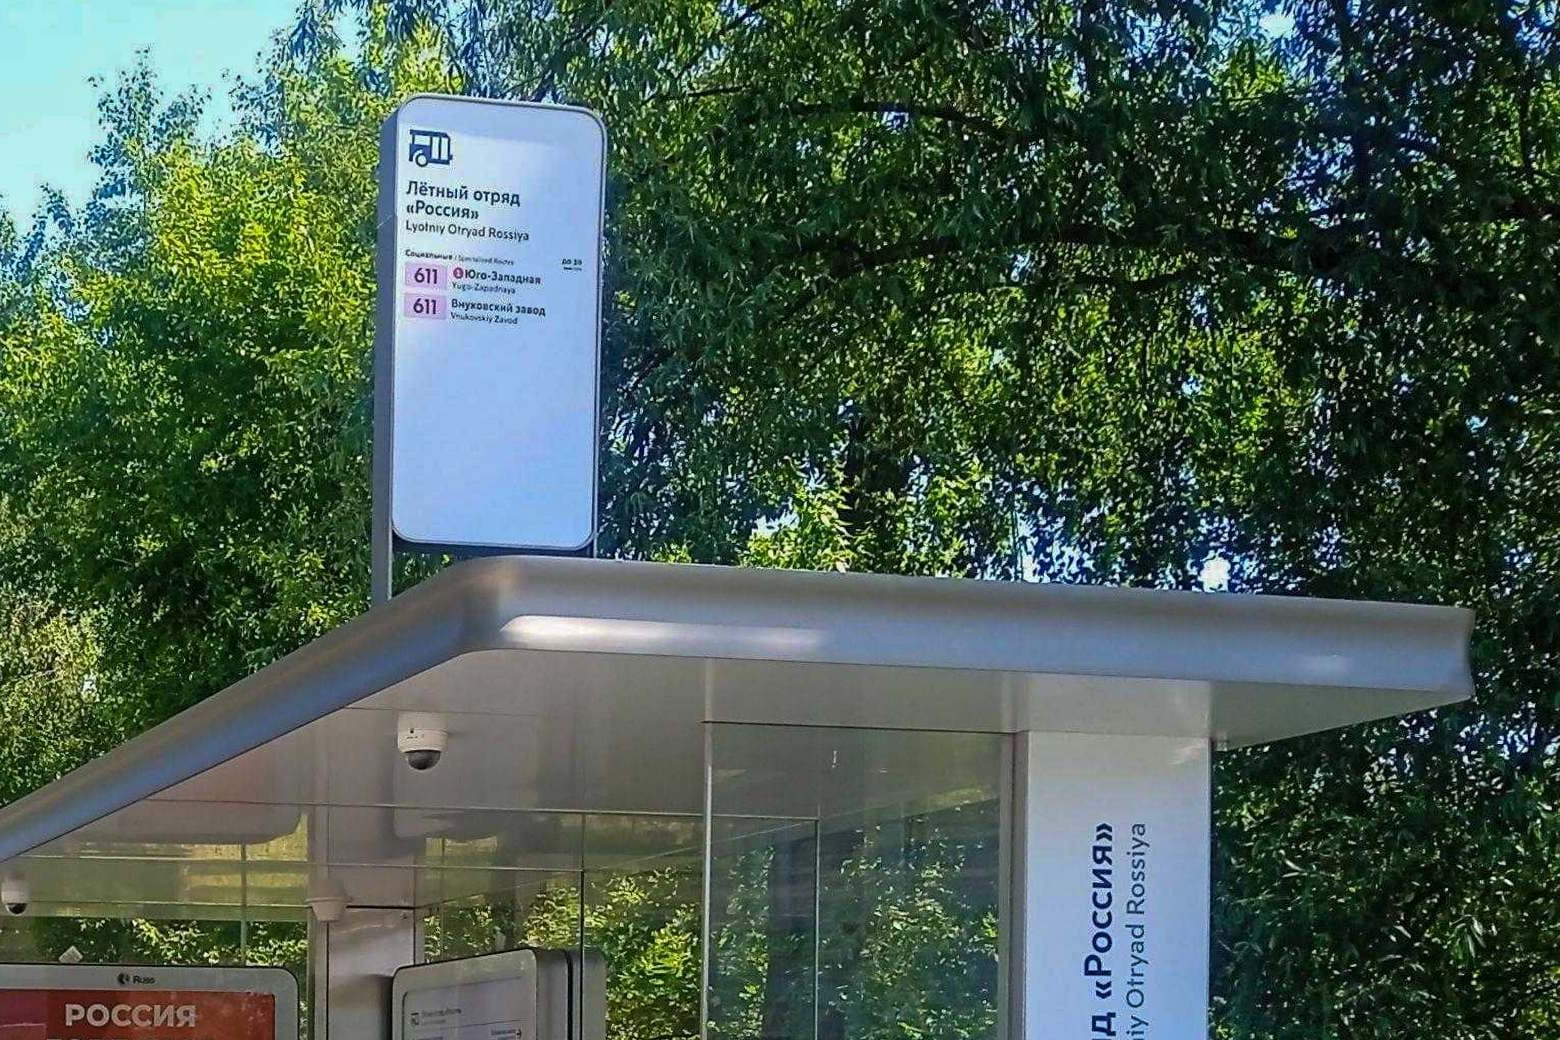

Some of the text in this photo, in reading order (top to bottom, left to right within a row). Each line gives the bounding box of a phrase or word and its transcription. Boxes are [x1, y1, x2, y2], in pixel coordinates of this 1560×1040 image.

[407, 181, 521, 207] Лётный отряд
[406, 200, 479, 219] «Россия»
[405, 220, 530, 242] Lyotniy Otryad Rossiya
[414, 267, 438, 285] 611
[465, 268, 542, 285] Юго-Западная
[413, 298, 546, 317] 611 Внуковский завод
[1126, 823, 1150, 915] Rossiya
[1084, 823, 1113, 1000] «Россия»
[1125, 924, 1149, 1009] Otryad
[65, 1003, 197, 1027] РОССИЯ
